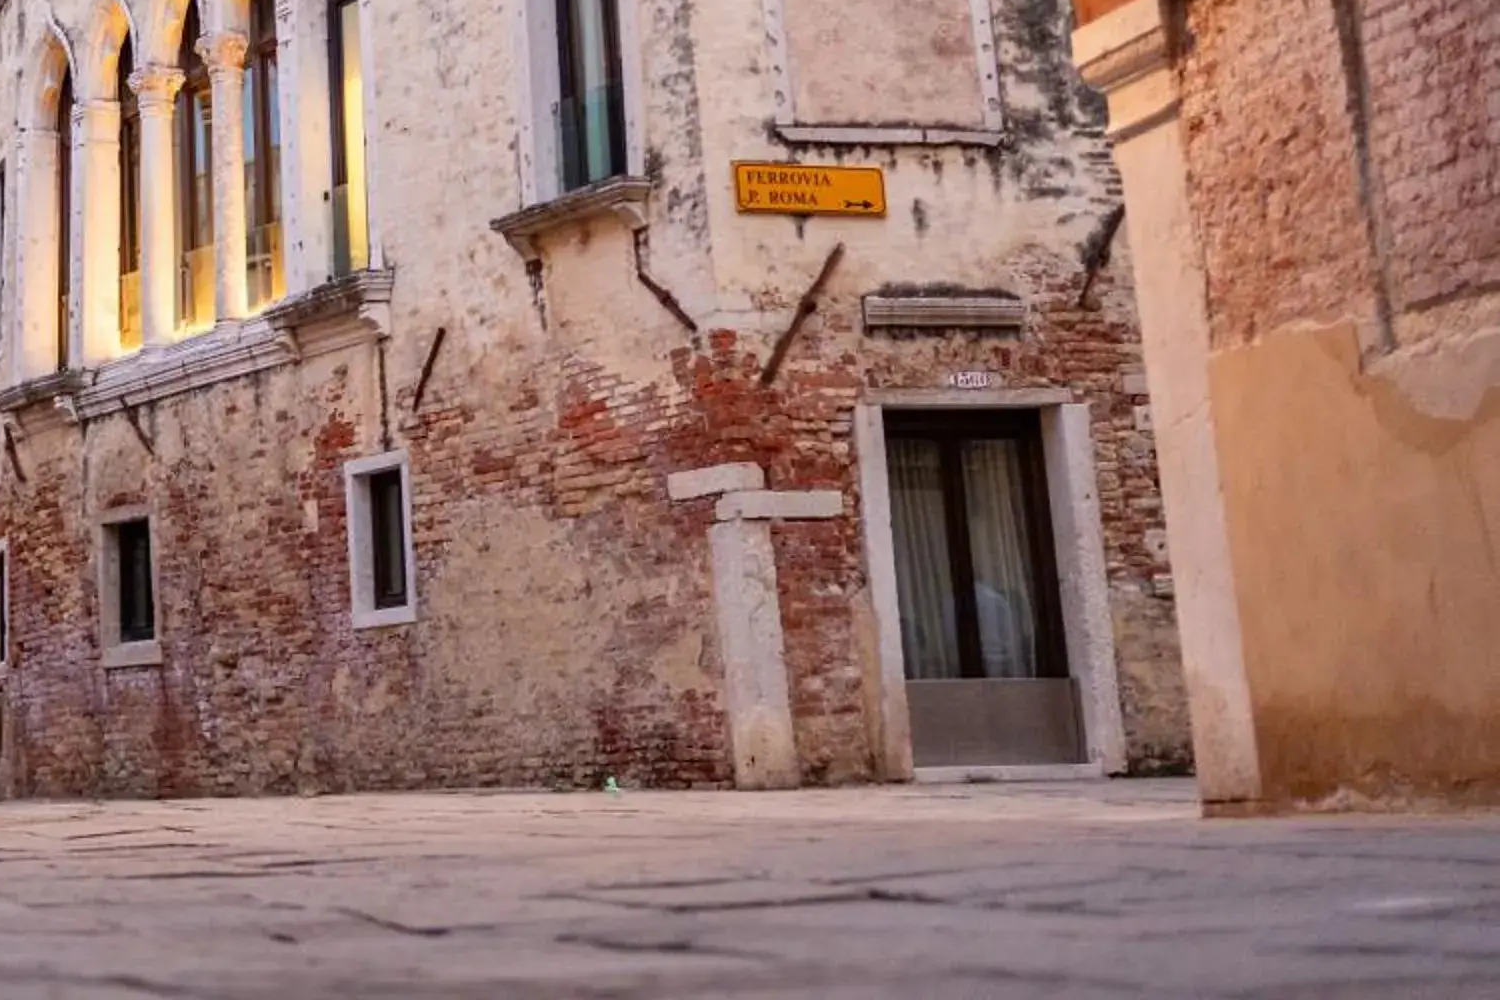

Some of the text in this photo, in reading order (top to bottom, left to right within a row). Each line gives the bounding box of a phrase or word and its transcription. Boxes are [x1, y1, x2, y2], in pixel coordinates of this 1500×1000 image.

[746, 170, 833, 187] FERROVIA
[748, 190, 819, 206] P. ROMA
